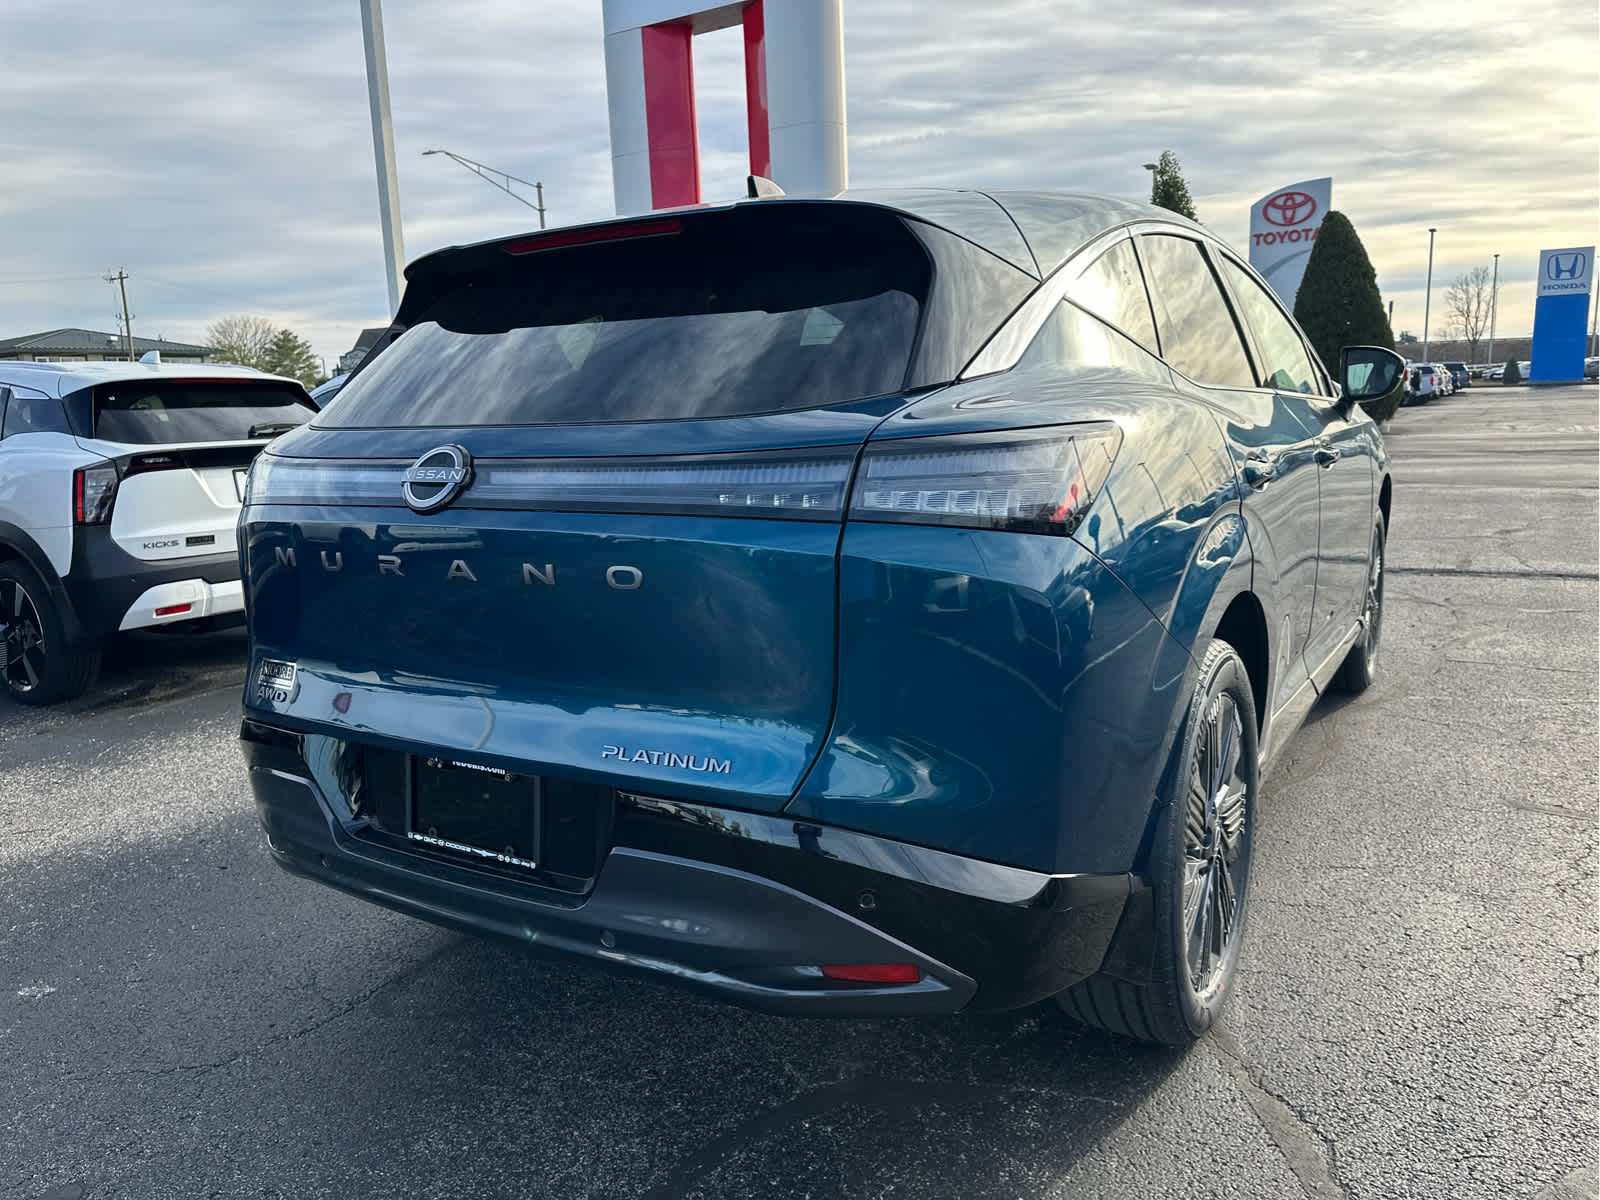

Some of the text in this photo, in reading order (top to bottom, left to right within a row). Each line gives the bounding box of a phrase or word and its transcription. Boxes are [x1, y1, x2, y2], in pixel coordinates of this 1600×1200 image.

[406, 470, 462, 480] NISSAN
[143, 540, 179, 549] KICKS
[274, 546, 644, 590] MURANO
[256, 687, 288, 703] AWD
[602, 744, 732, 774] PLATINUM
